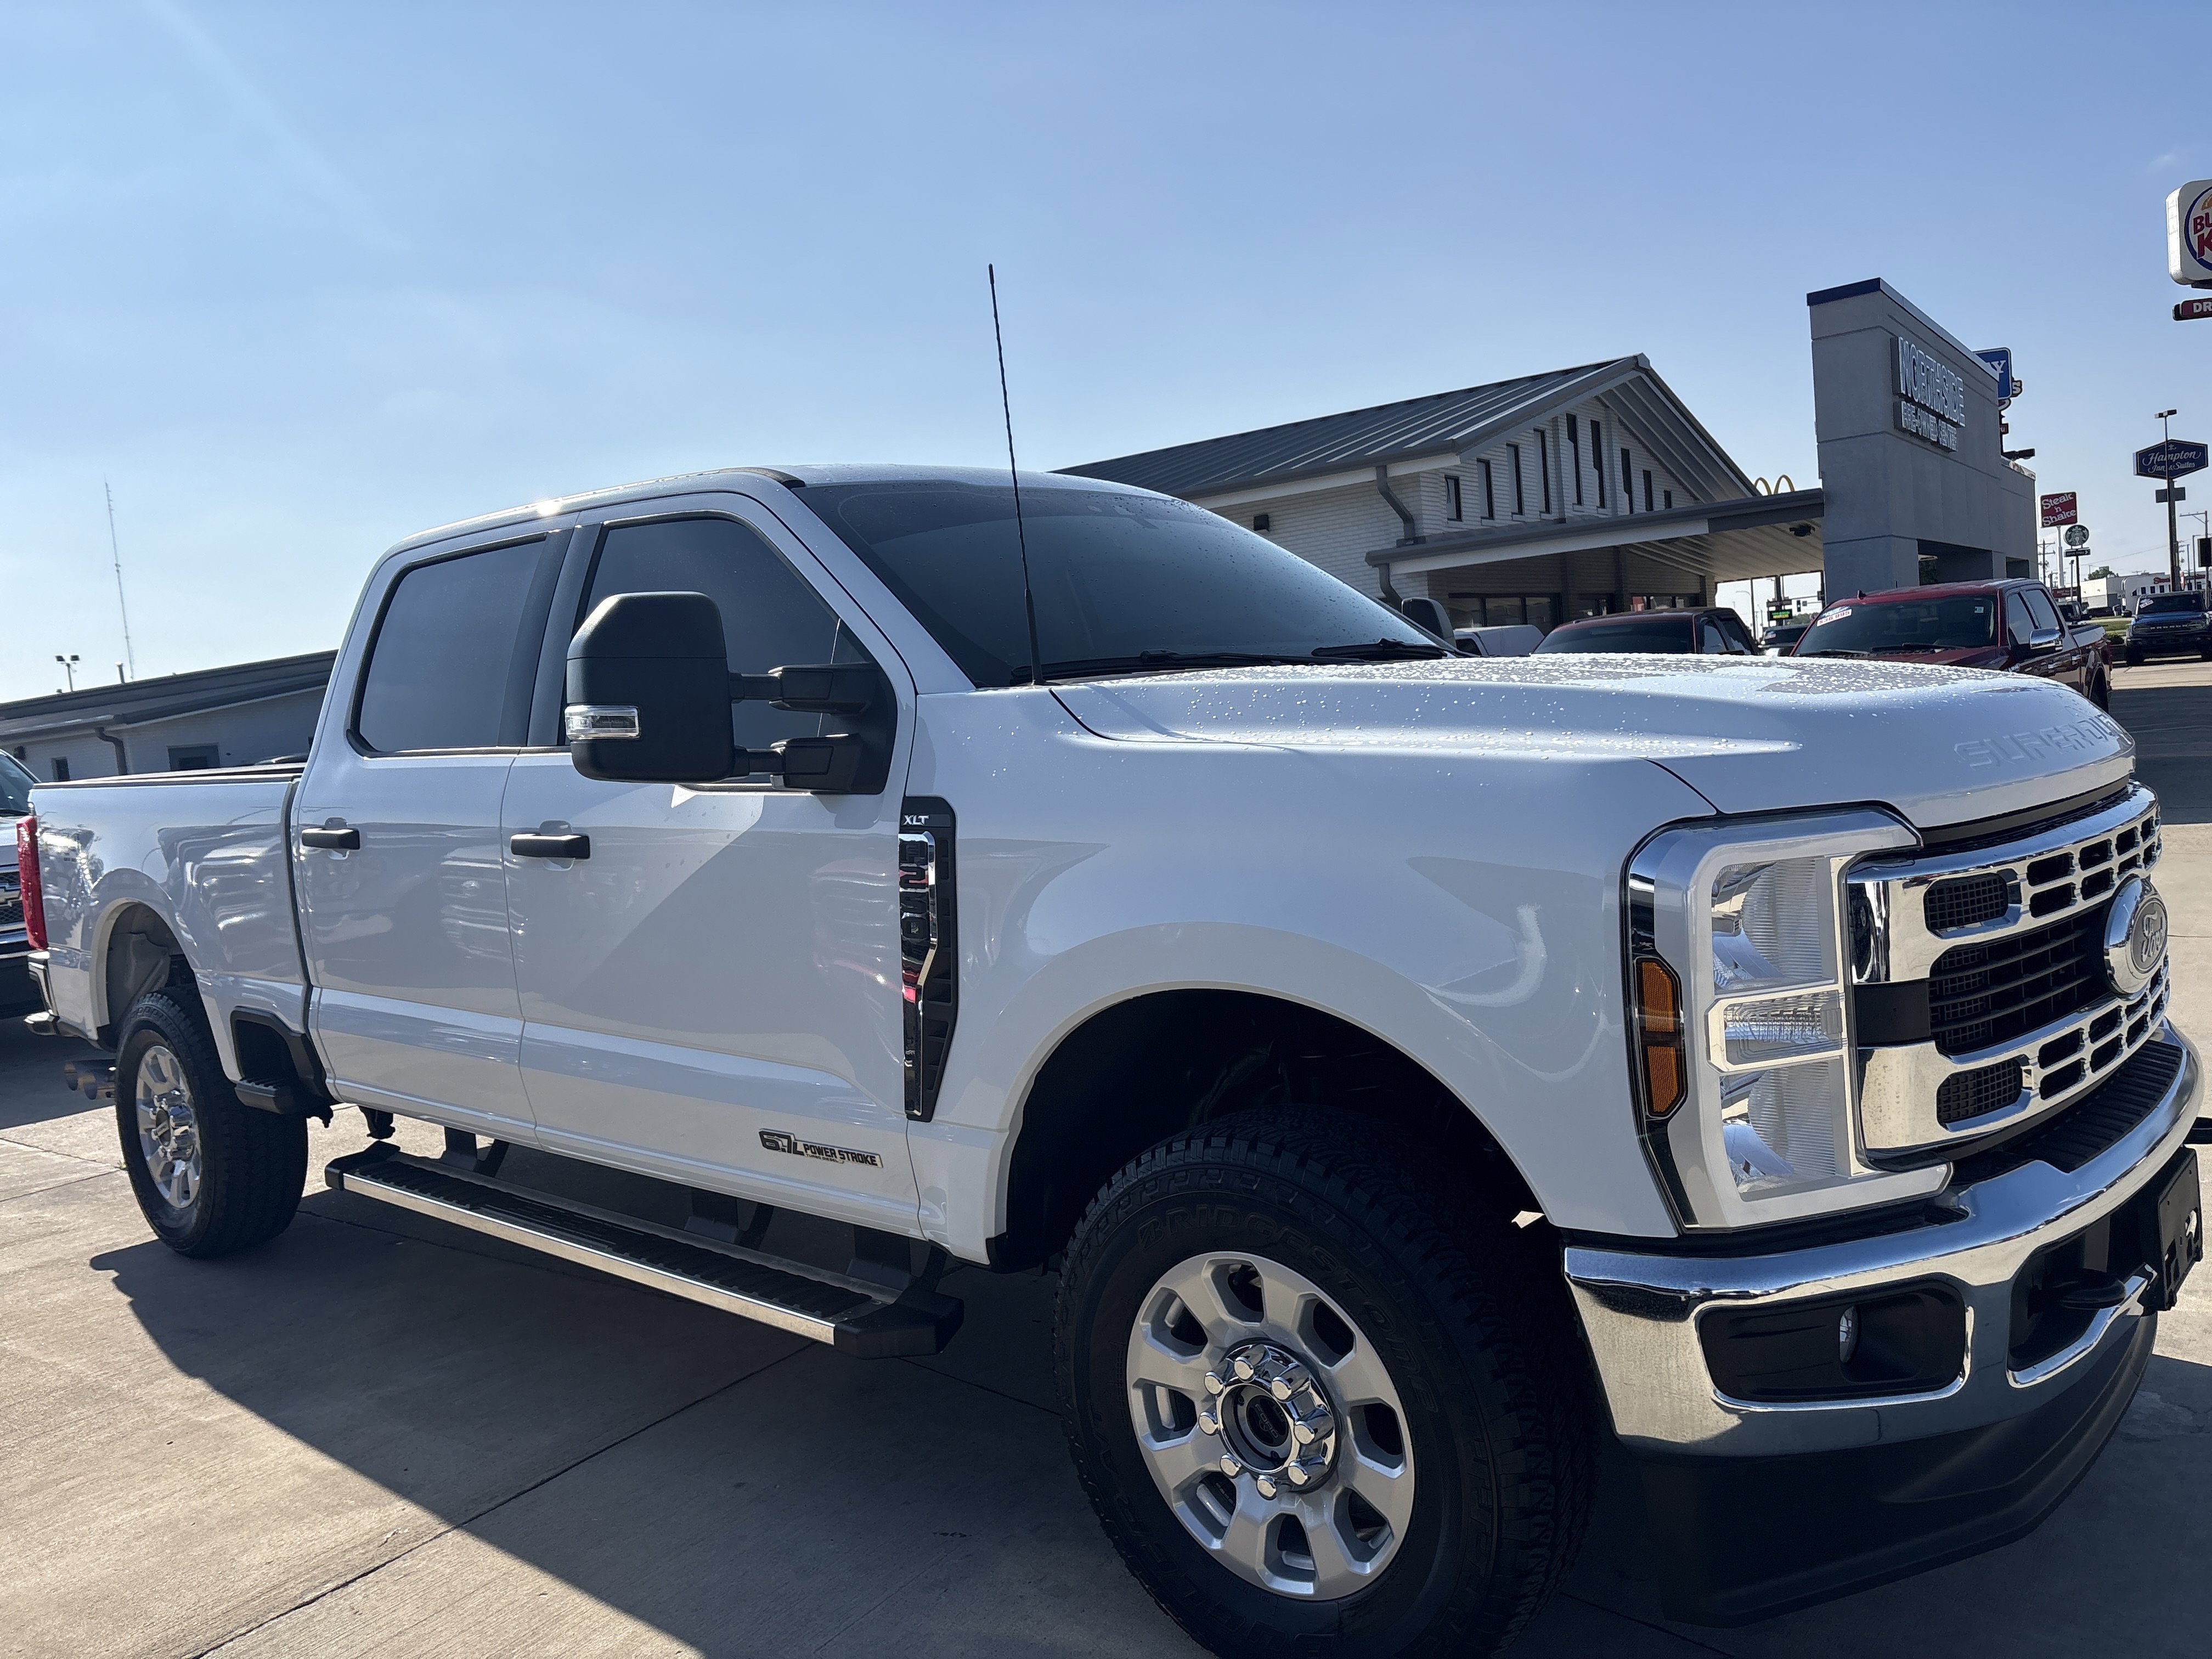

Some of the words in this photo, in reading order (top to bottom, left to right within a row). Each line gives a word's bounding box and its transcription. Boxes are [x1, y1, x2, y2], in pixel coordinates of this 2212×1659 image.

[1898, 336, 1966, 427] NORTHSIDE
[2142, 450, 2202, 466] Hampton
[2147, 465, 2166, 473] Inn
[2041, 493, 2074, 510] Steak
[2042, 509, 2076, 527] Shake
[903, 815, 929, 826] XLT
[803, 1143, 837, 1159] POWER
[838, 1149, 878, 1166] STROKE
[1137, 1203, 1438, 1413] BRIDGESTONE
